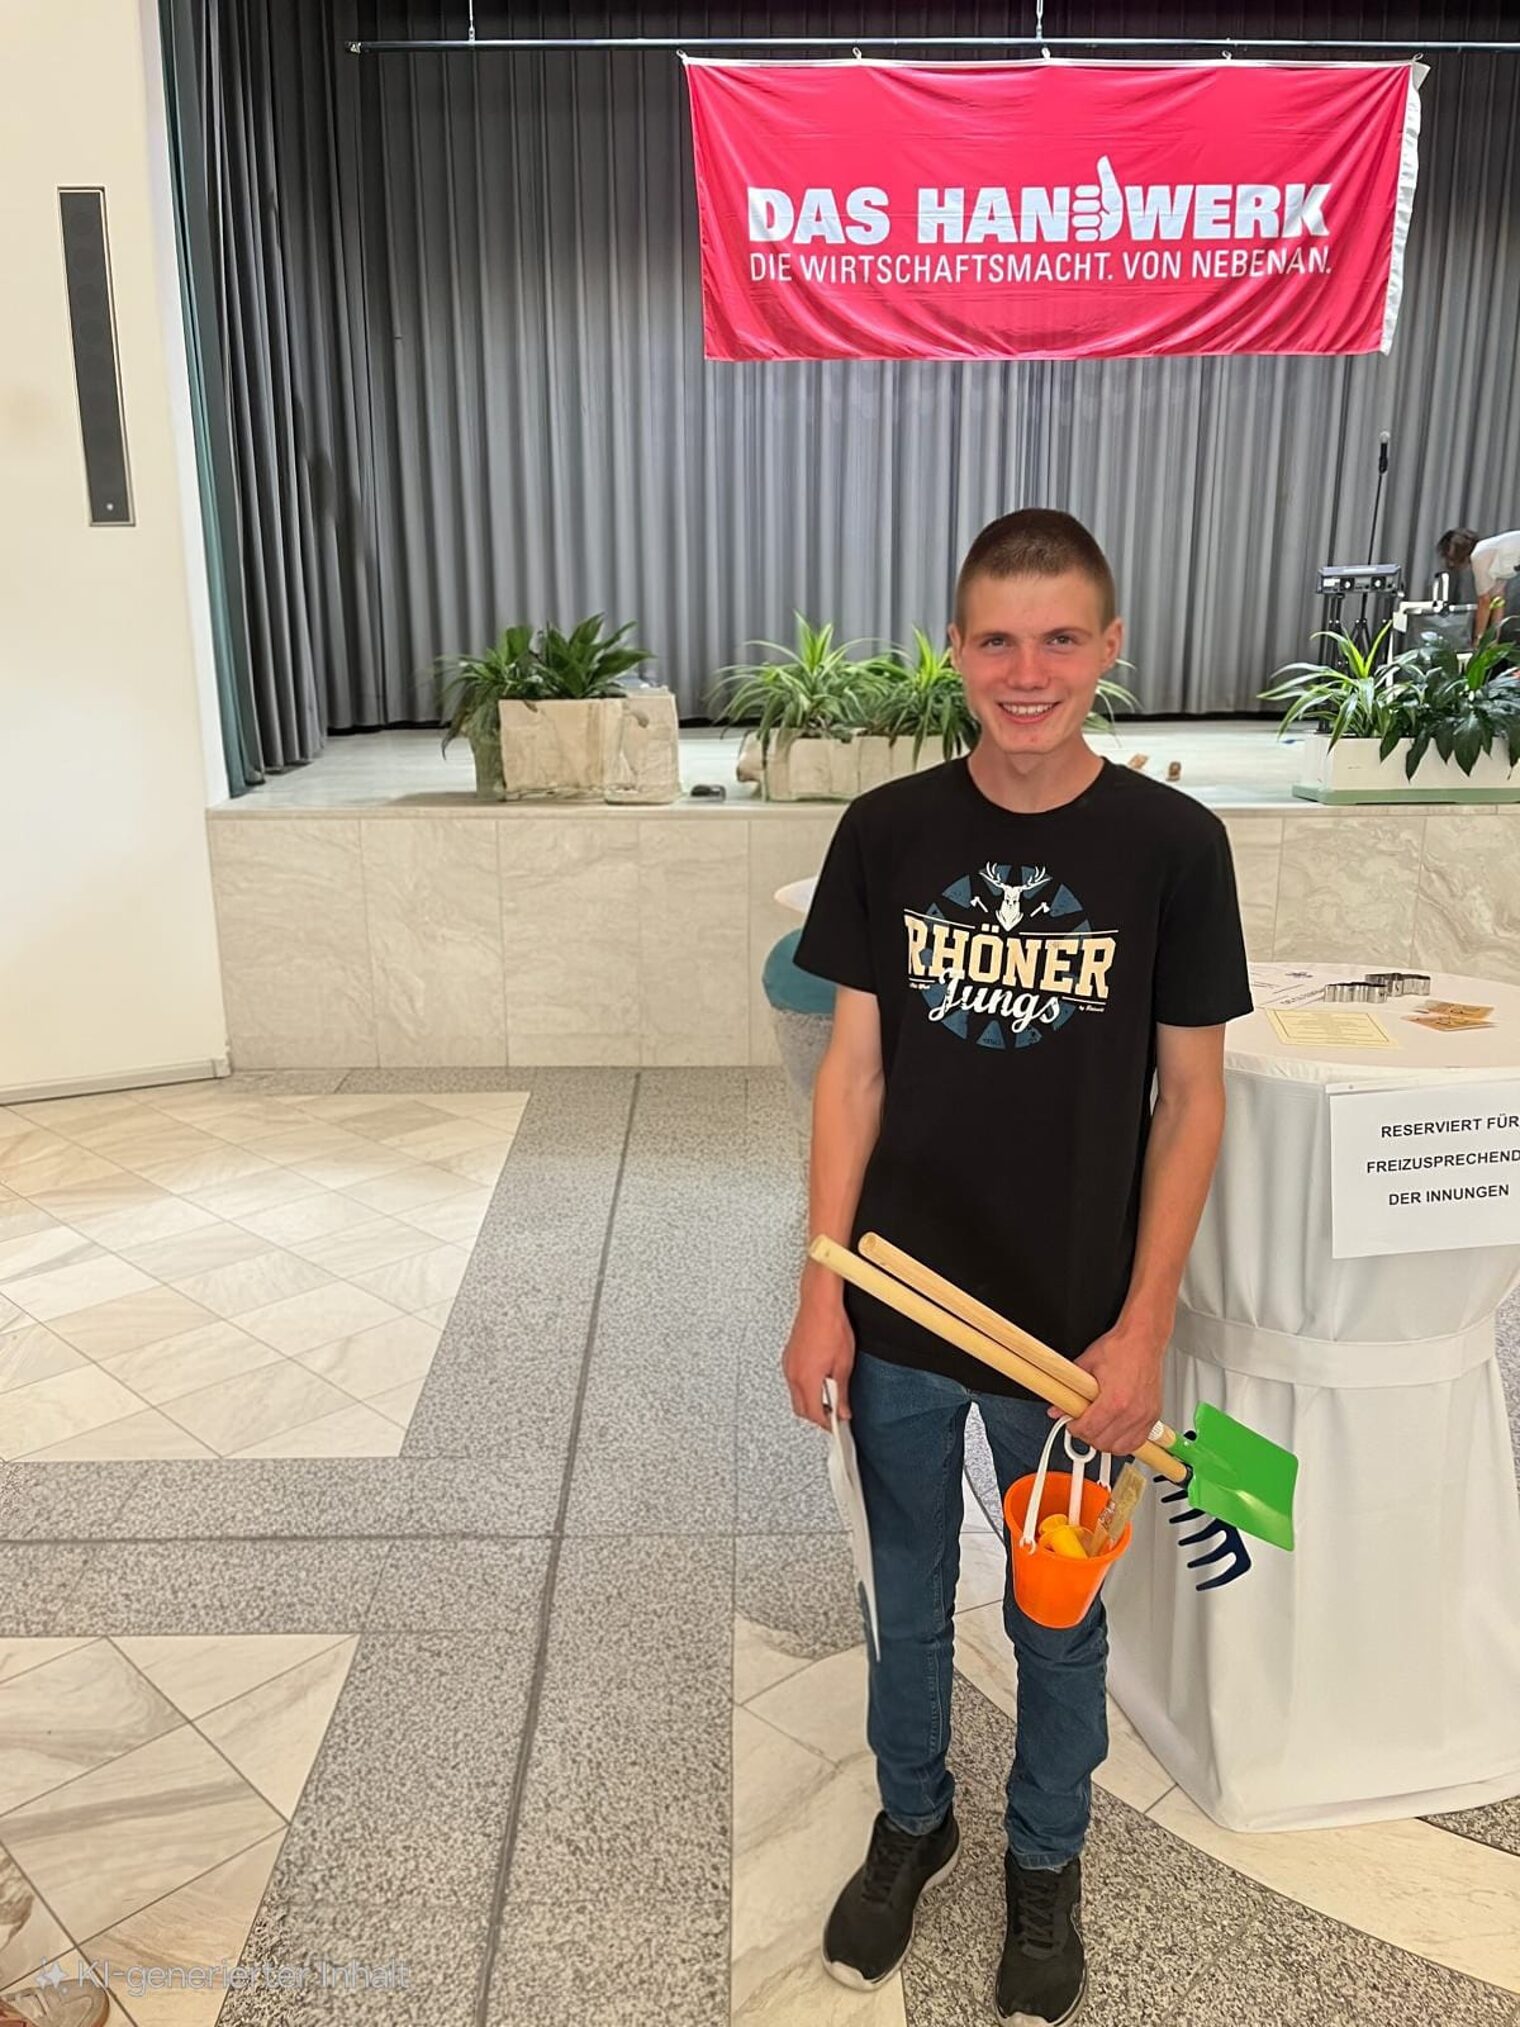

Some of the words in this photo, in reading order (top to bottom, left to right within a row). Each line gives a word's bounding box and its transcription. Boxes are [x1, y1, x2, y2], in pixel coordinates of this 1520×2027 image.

[747, 185, 890, 245] DAS
[917, 156, 1333, 244] HANDWERK
[749, 252, 793, 283] DIE
[799, 251, 1114, 284] WIRTSCHAFTSMACHT.
[1122, 250, 1182, 281] VON
[1190, 245, 1333, 279] NEBENAN.
[903, 914, 1117, 998] RHÖNER
[928, 967, 1061, 1034] Jungs
[1380, 1118, 1482, 1139] RESERVIERT
[1486, 1112, 1520, 1130] FÜR
[1388, 1191, 1422, 1207] DER
[1426, 1184, 1510, 1203] INNUNGEN
